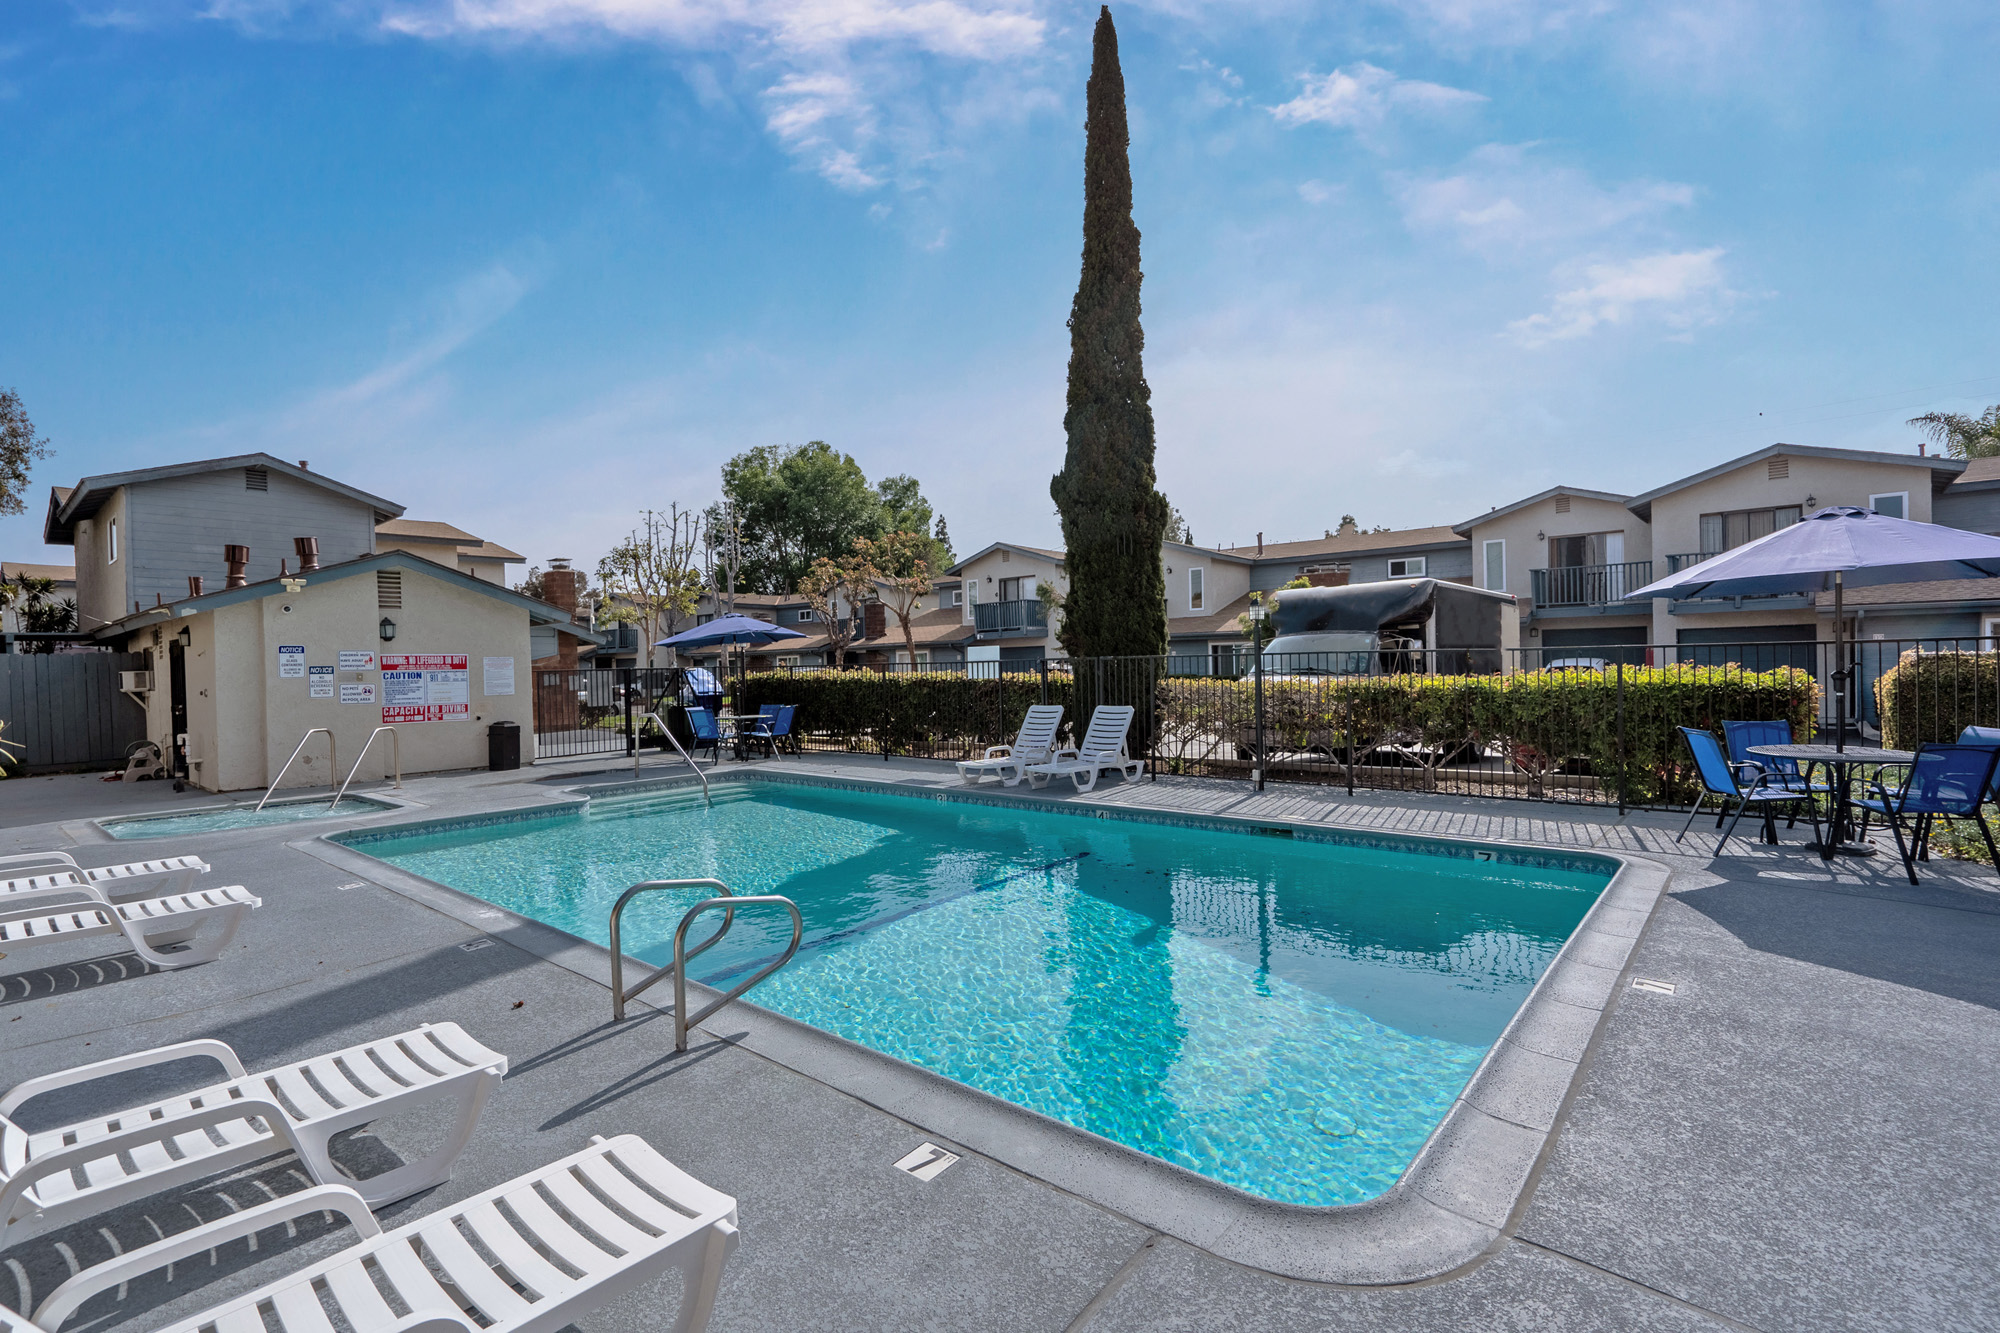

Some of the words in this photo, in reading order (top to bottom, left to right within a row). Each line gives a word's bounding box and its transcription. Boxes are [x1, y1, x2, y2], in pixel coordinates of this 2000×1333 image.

[382, 656, 408, 665] WARNING:
[408, 656, 416, 665] NO
[417, 656, 444, 664] LIFEGUARD
[445, 656, 451, 664] ON
[452, 656, 466, 664] DUTY
[383, 672, 422, 680] CAUTION
[429, 674, 439, 682] 911
[383, 706, 424, 716] CAPACITY
[430, 705, 439, 713] NO
[442, 704, 466, 713] DIVING
[1478, 852, 1492, 862] 7
[906, 1148, 947, 1172] 7
[944, 1155, 957, 1163] FT
